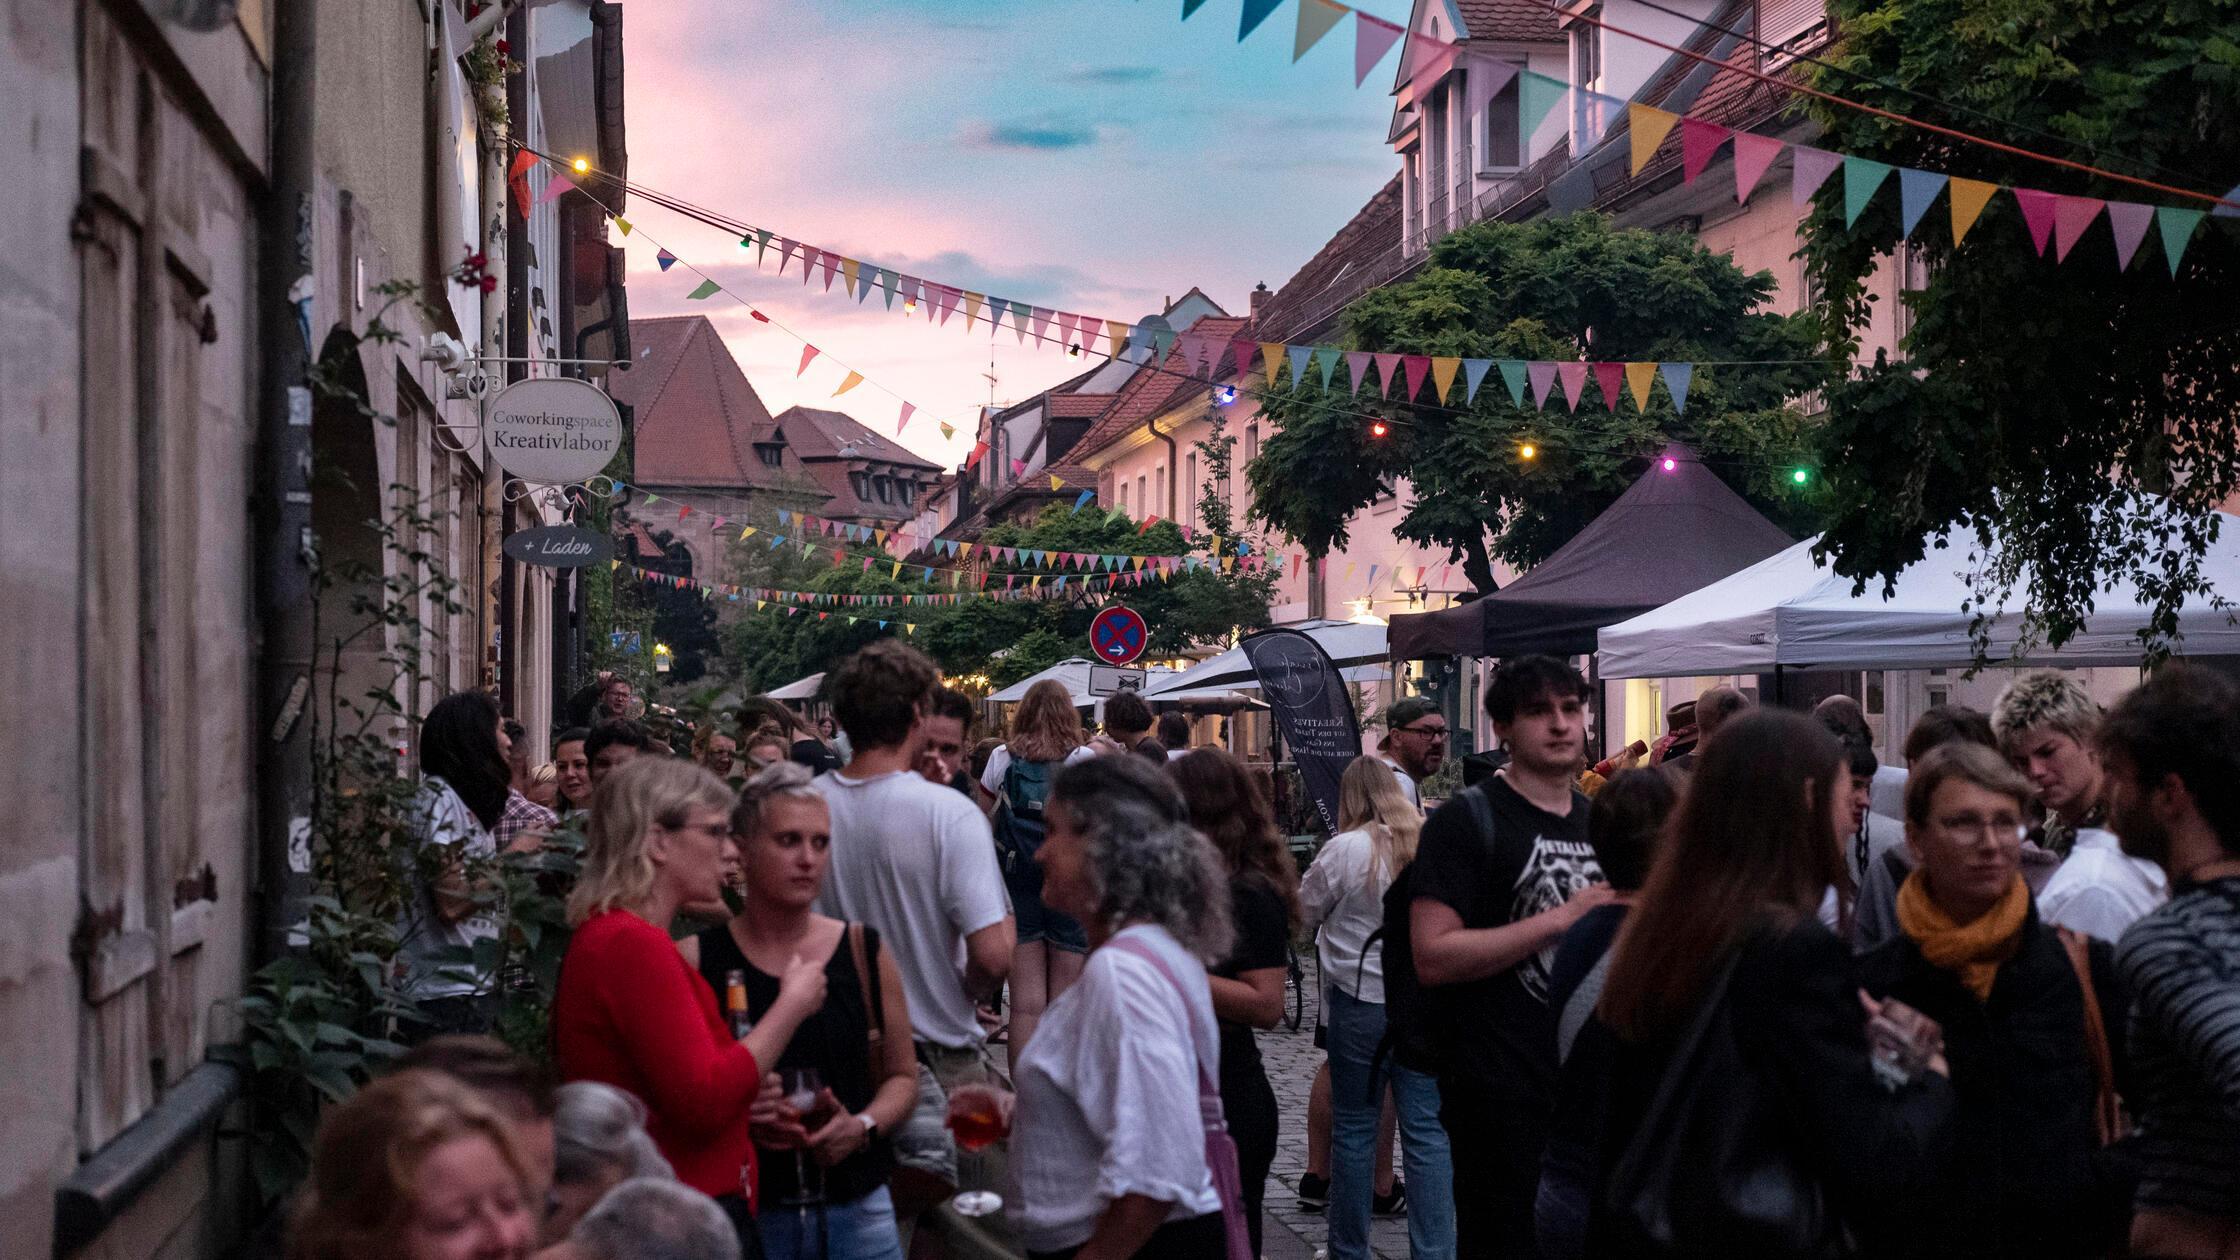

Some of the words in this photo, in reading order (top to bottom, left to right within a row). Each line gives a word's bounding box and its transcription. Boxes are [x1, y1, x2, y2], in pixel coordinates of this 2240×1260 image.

[493, 410, 613, 430] Coworkingspace
[493, 430, 613, 451] Kreativlabor
[541, 536, 593, 556] Laden
